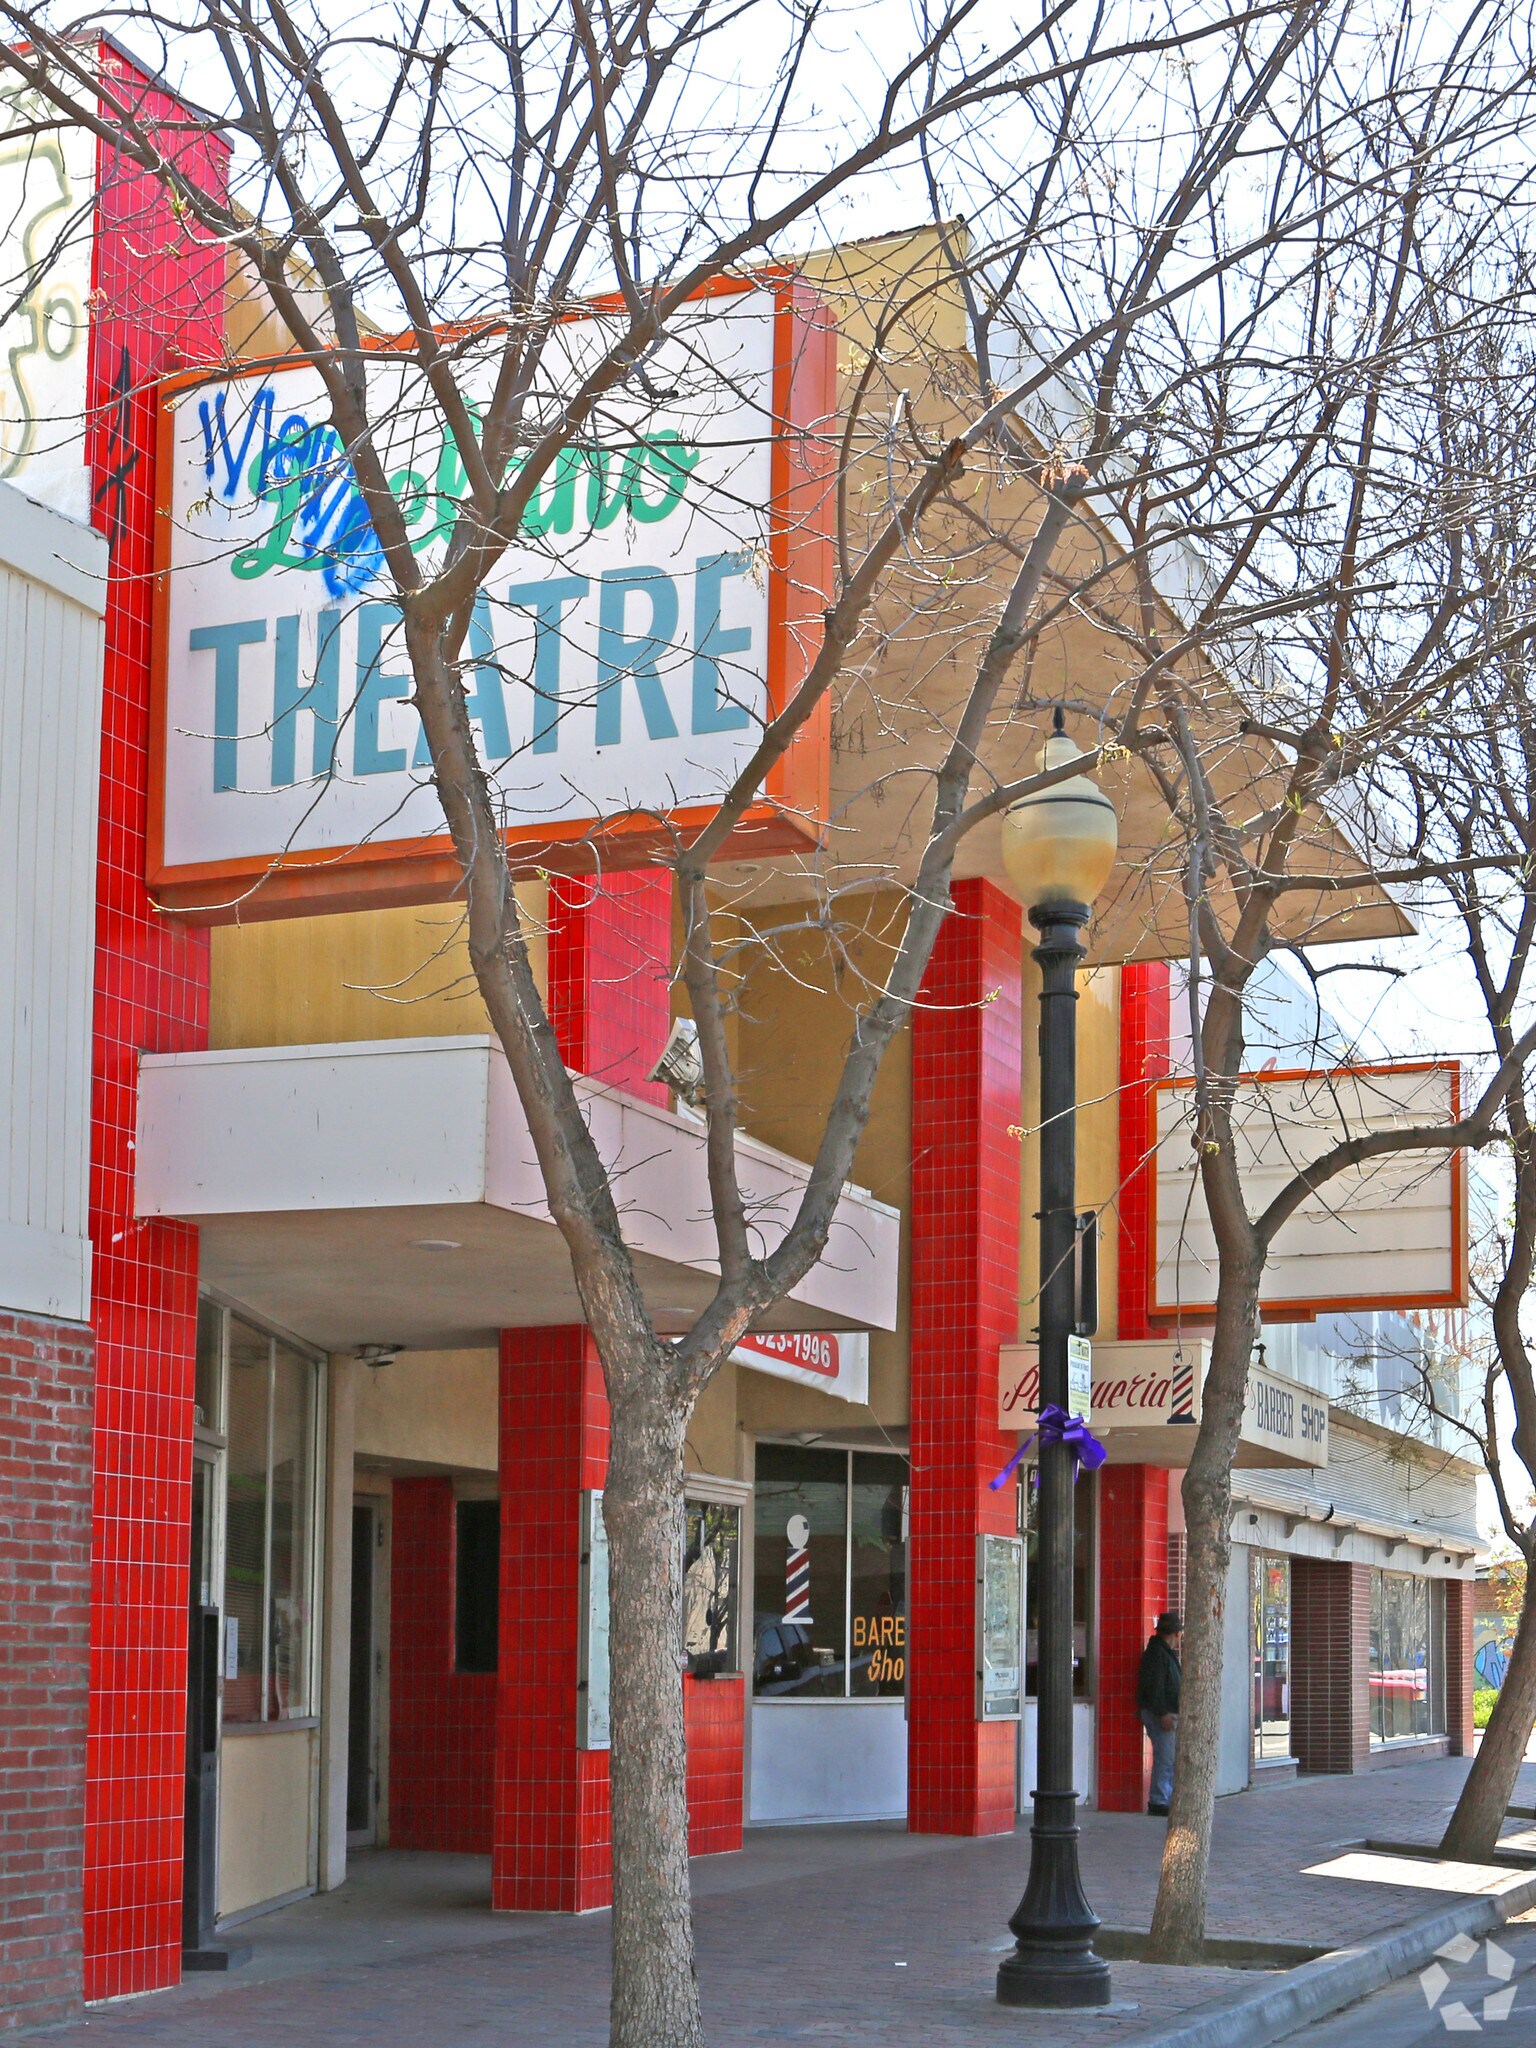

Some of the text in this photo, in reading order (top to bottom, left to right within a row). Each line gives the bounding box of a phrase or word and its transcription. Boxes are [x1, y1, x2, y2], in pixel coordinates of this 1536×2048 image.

[190, 550, 752, 793] THEATRE
[1002, 1363, 1173, 1412] Peueria
[1257, 1381, 1294, 1439] BARBER
[1301, 1403, 1326, 1443] SHOP
